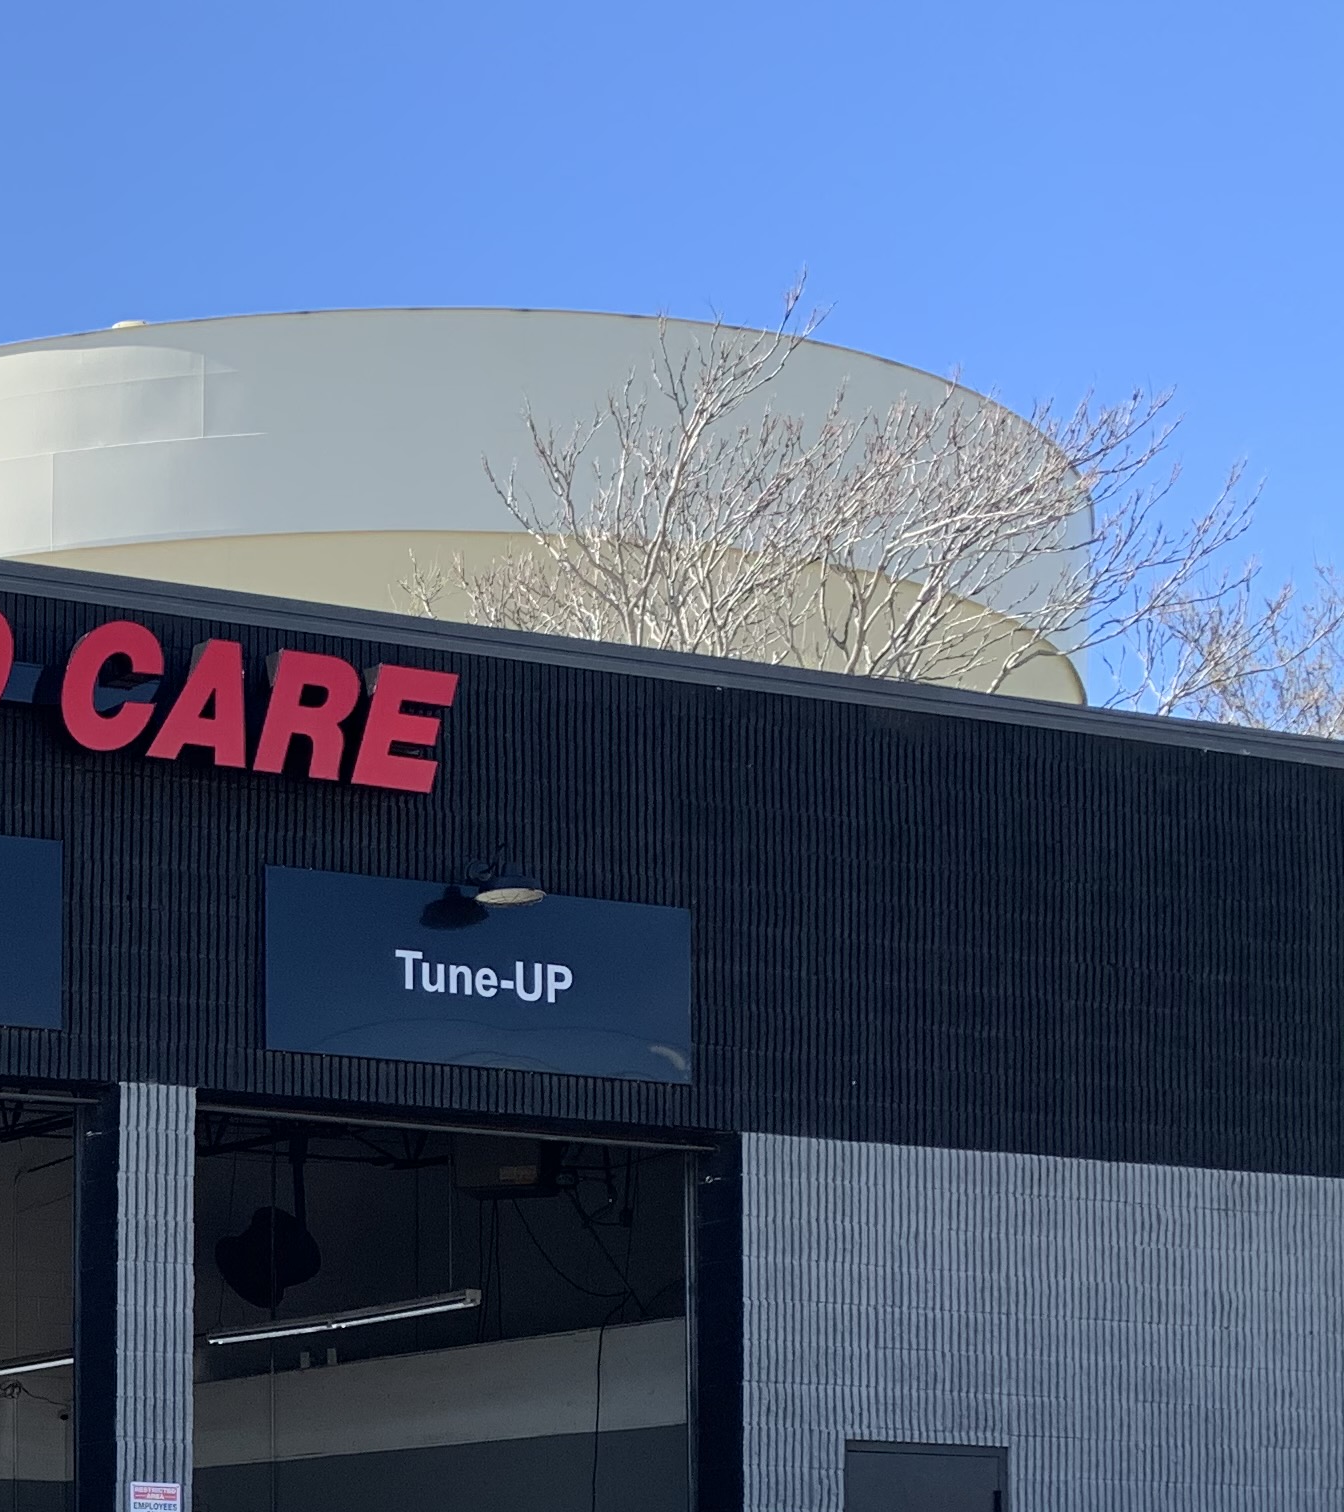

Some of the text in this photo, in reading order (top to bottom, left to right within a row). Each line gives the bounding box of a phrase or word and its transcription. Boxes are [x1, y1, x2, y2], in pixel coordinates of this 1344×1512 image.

[61, 620, 459, 794] CARE
[395, 949, 574, 1004] Tune-UP
[133, 1502, 177, 1511] EMPLOYEES
